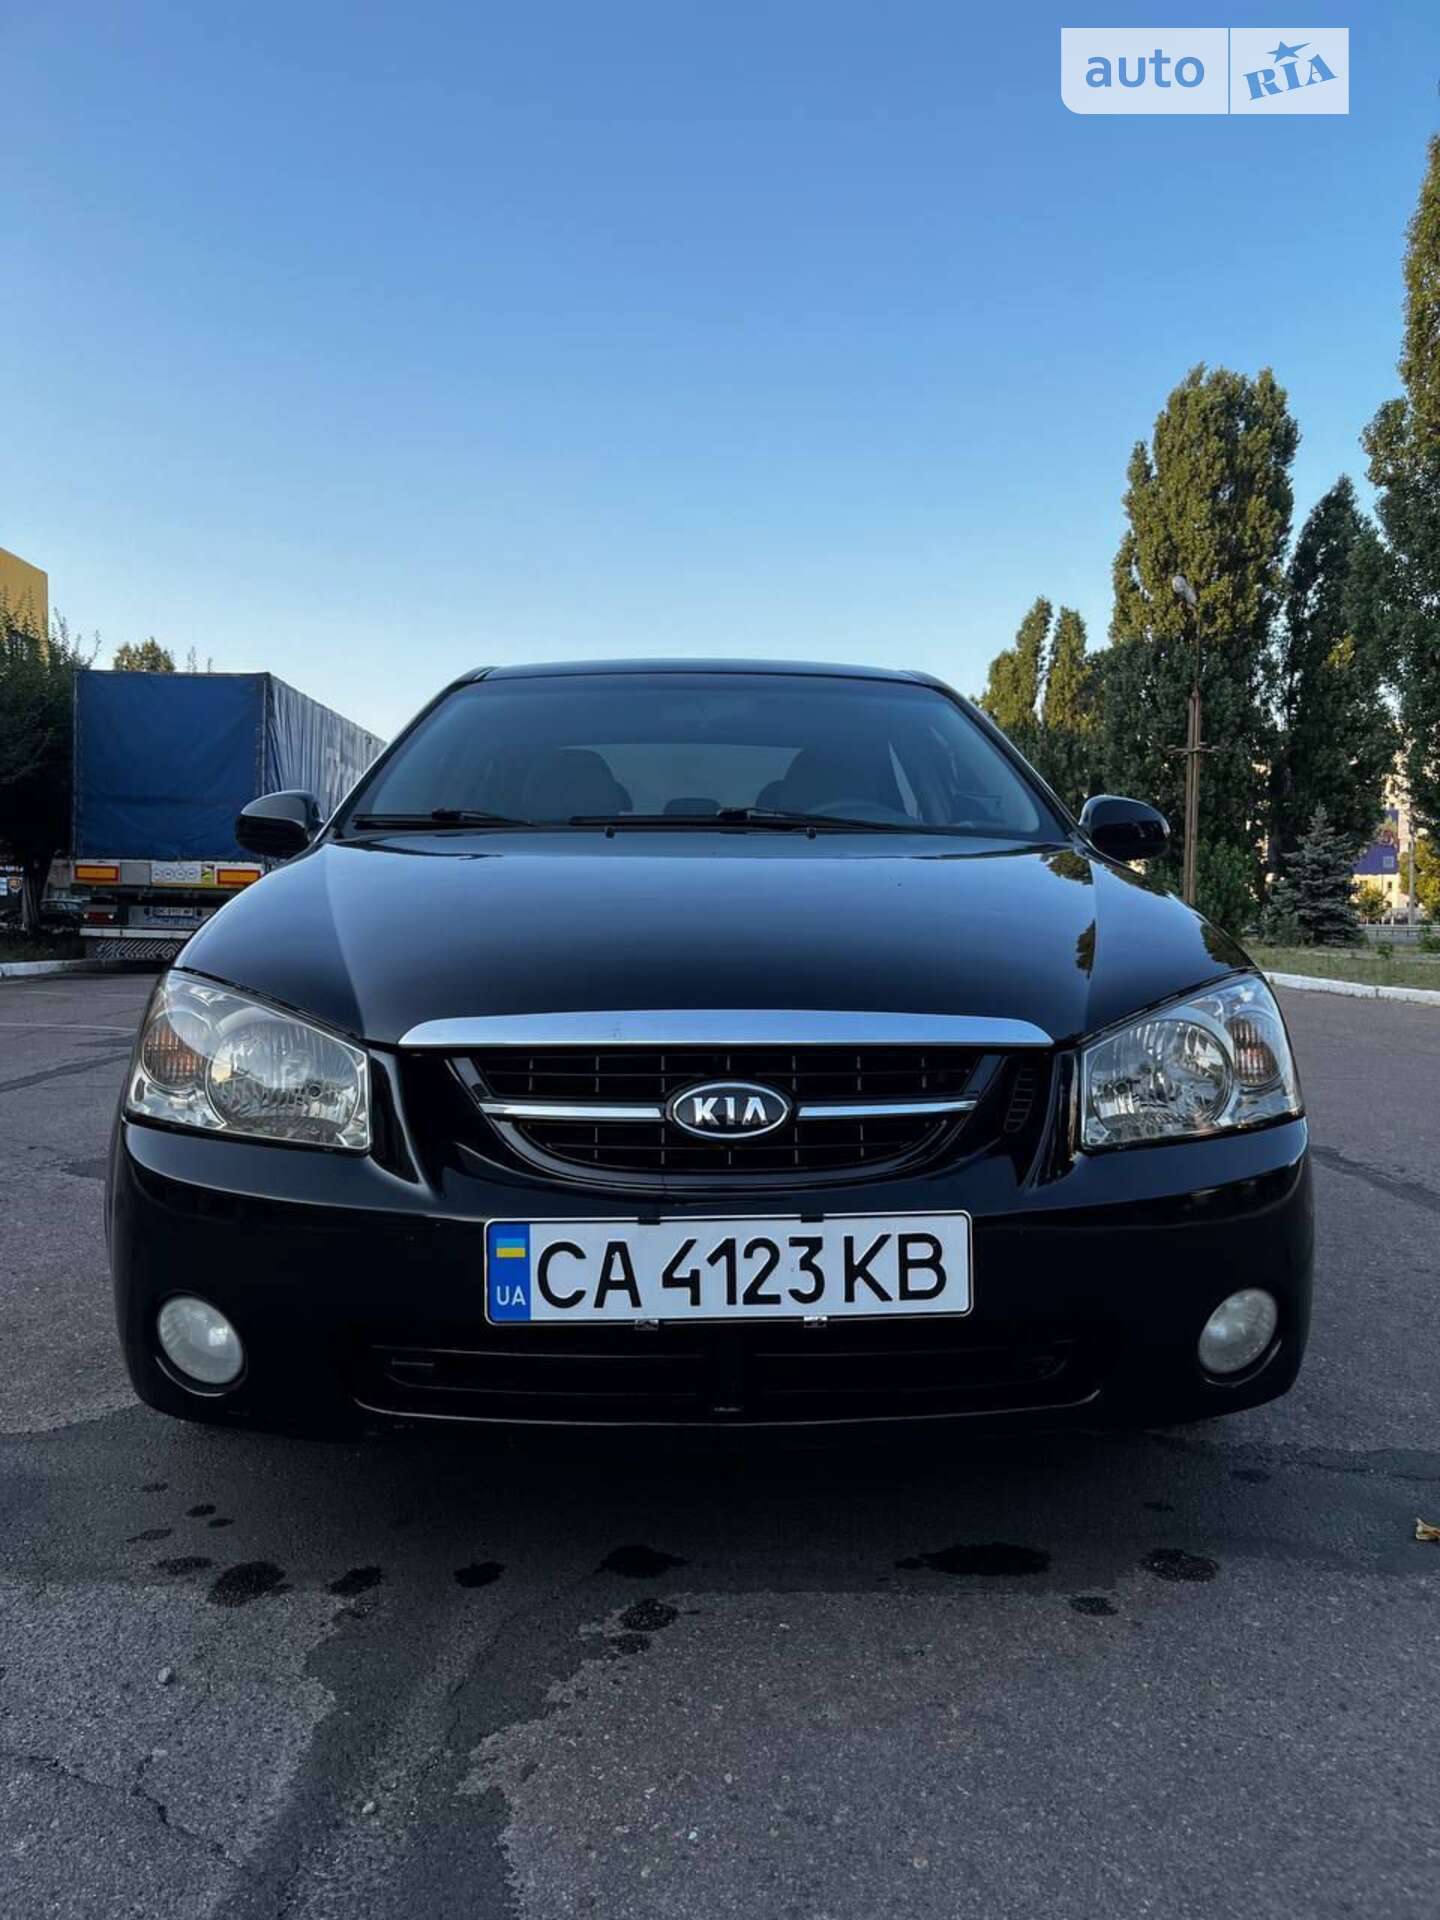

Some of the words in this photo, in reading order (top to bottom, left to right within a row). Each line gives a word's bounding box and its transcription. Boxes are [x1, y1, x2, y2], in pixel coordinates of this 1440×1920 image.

[692, 1096, 770, 1126] KIA
[537, 1241, 642, 1309] CA
[661, 1236, 826, 1306] 4123
[843, 1232, 948, 1303] KB
[496, 1284, 526, 1306] UA
